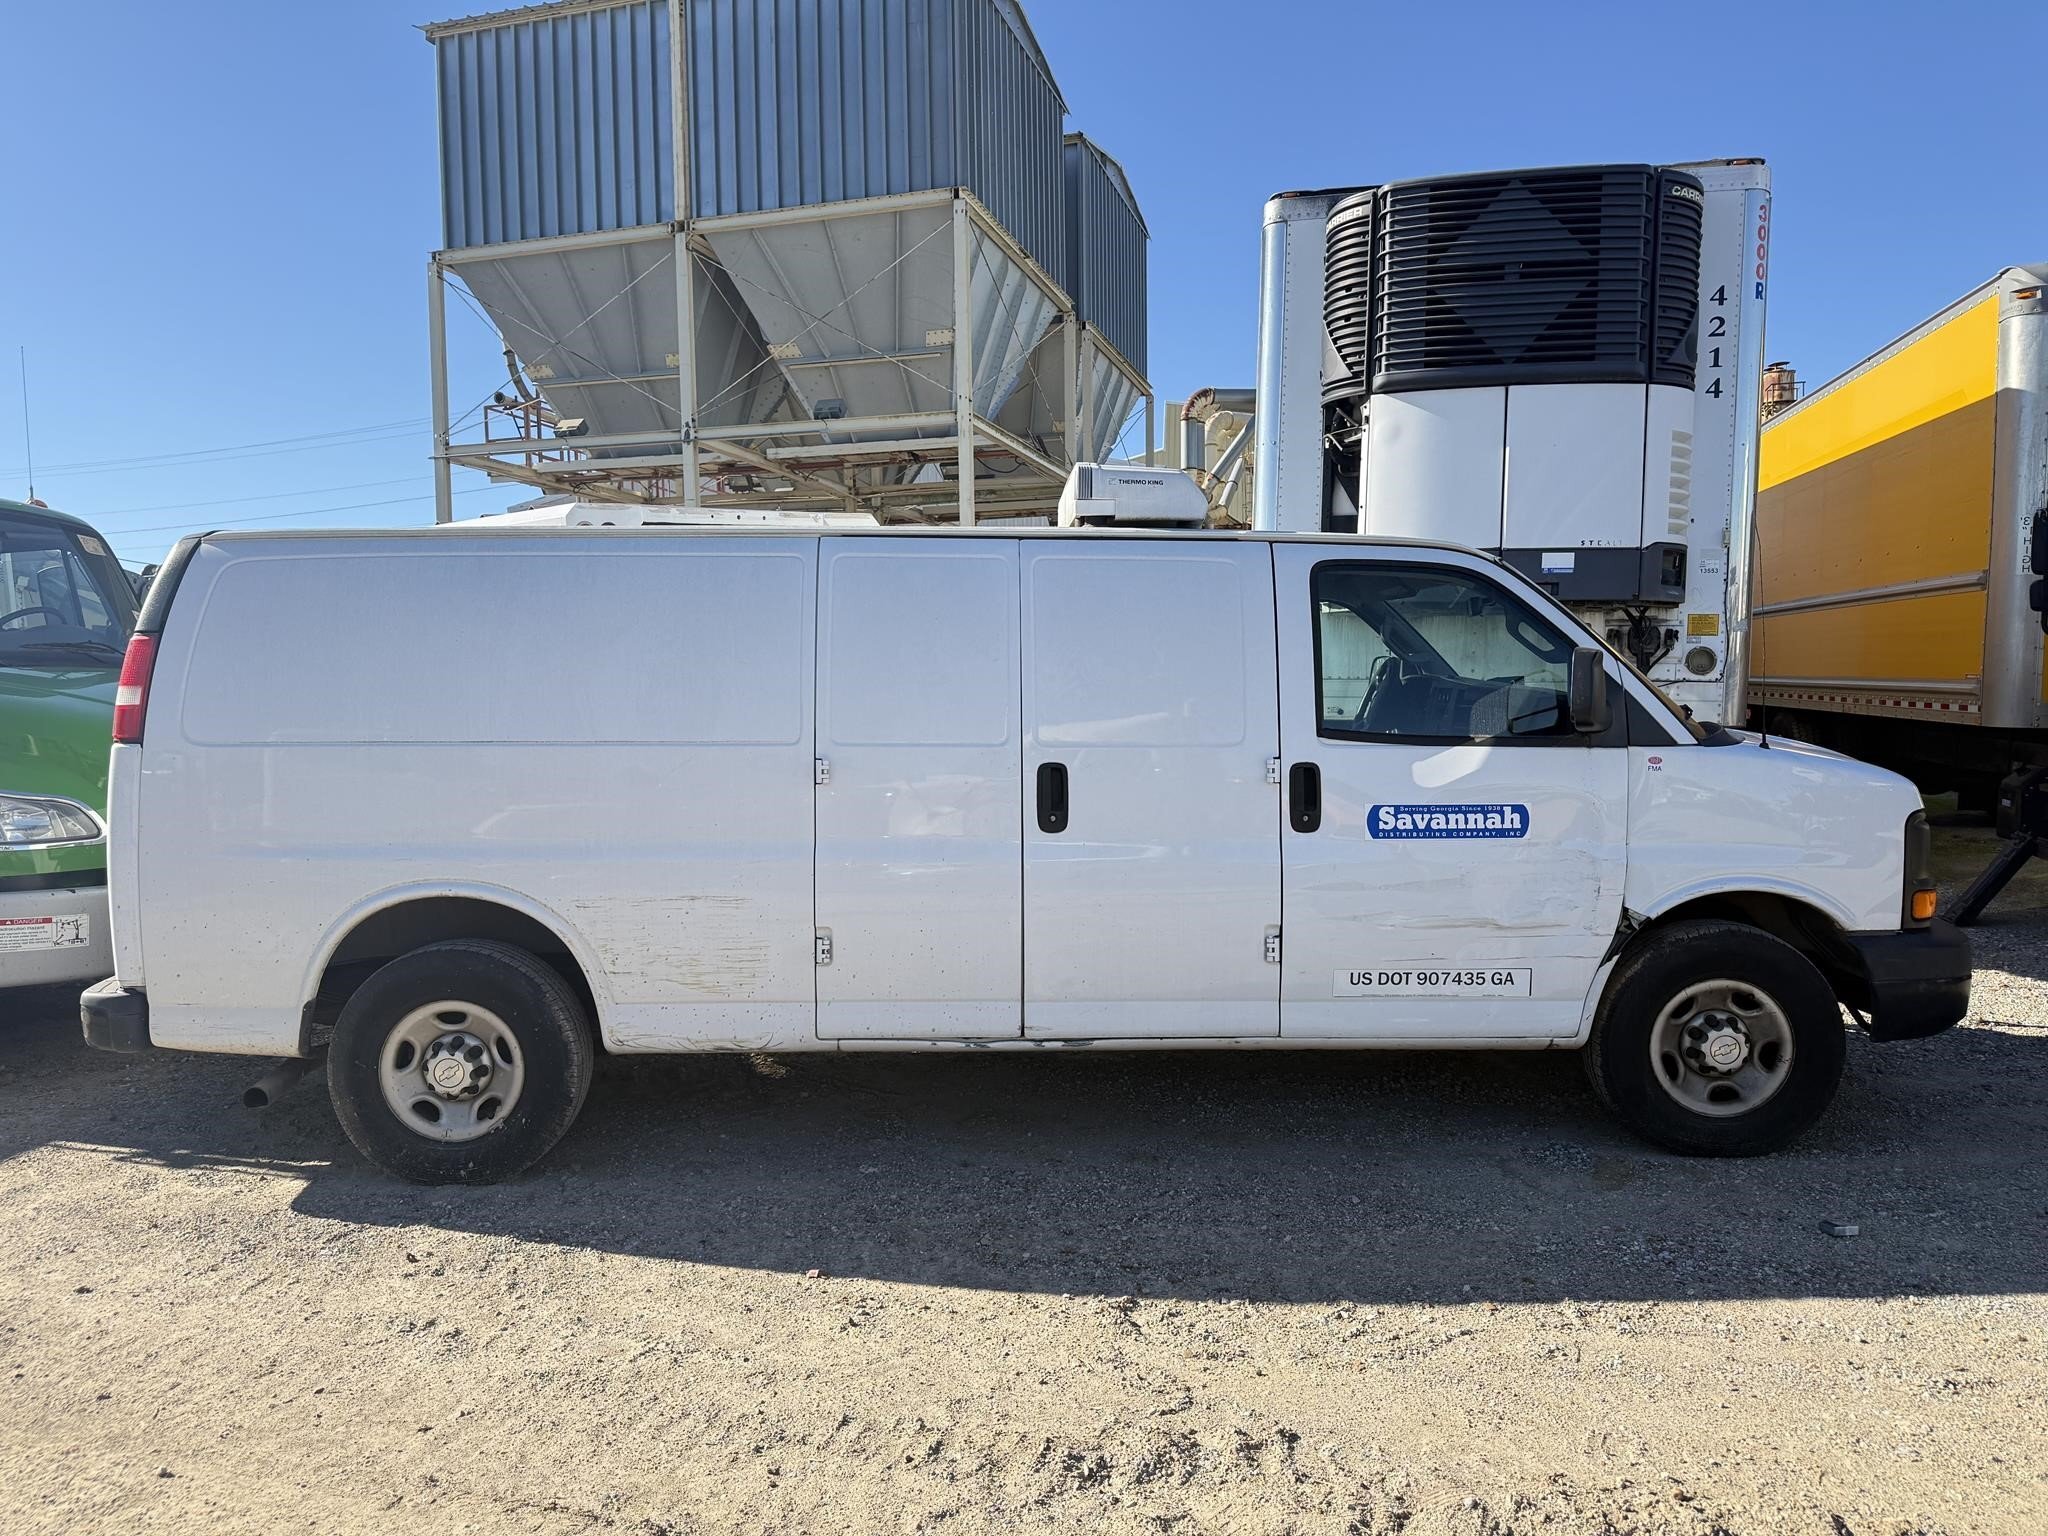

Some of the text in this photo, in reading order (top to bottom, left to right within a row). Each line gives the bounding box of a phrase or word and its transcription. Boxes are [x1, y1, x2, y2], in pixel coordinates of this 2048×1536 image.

[1756, 204, 1768, 299] 3000R
[1705, 285, 1728, 399] 4214
[1378, 806, 1522, 830] Savannah
[1350, 972, 1515, 986] US DOT 907435 GA
